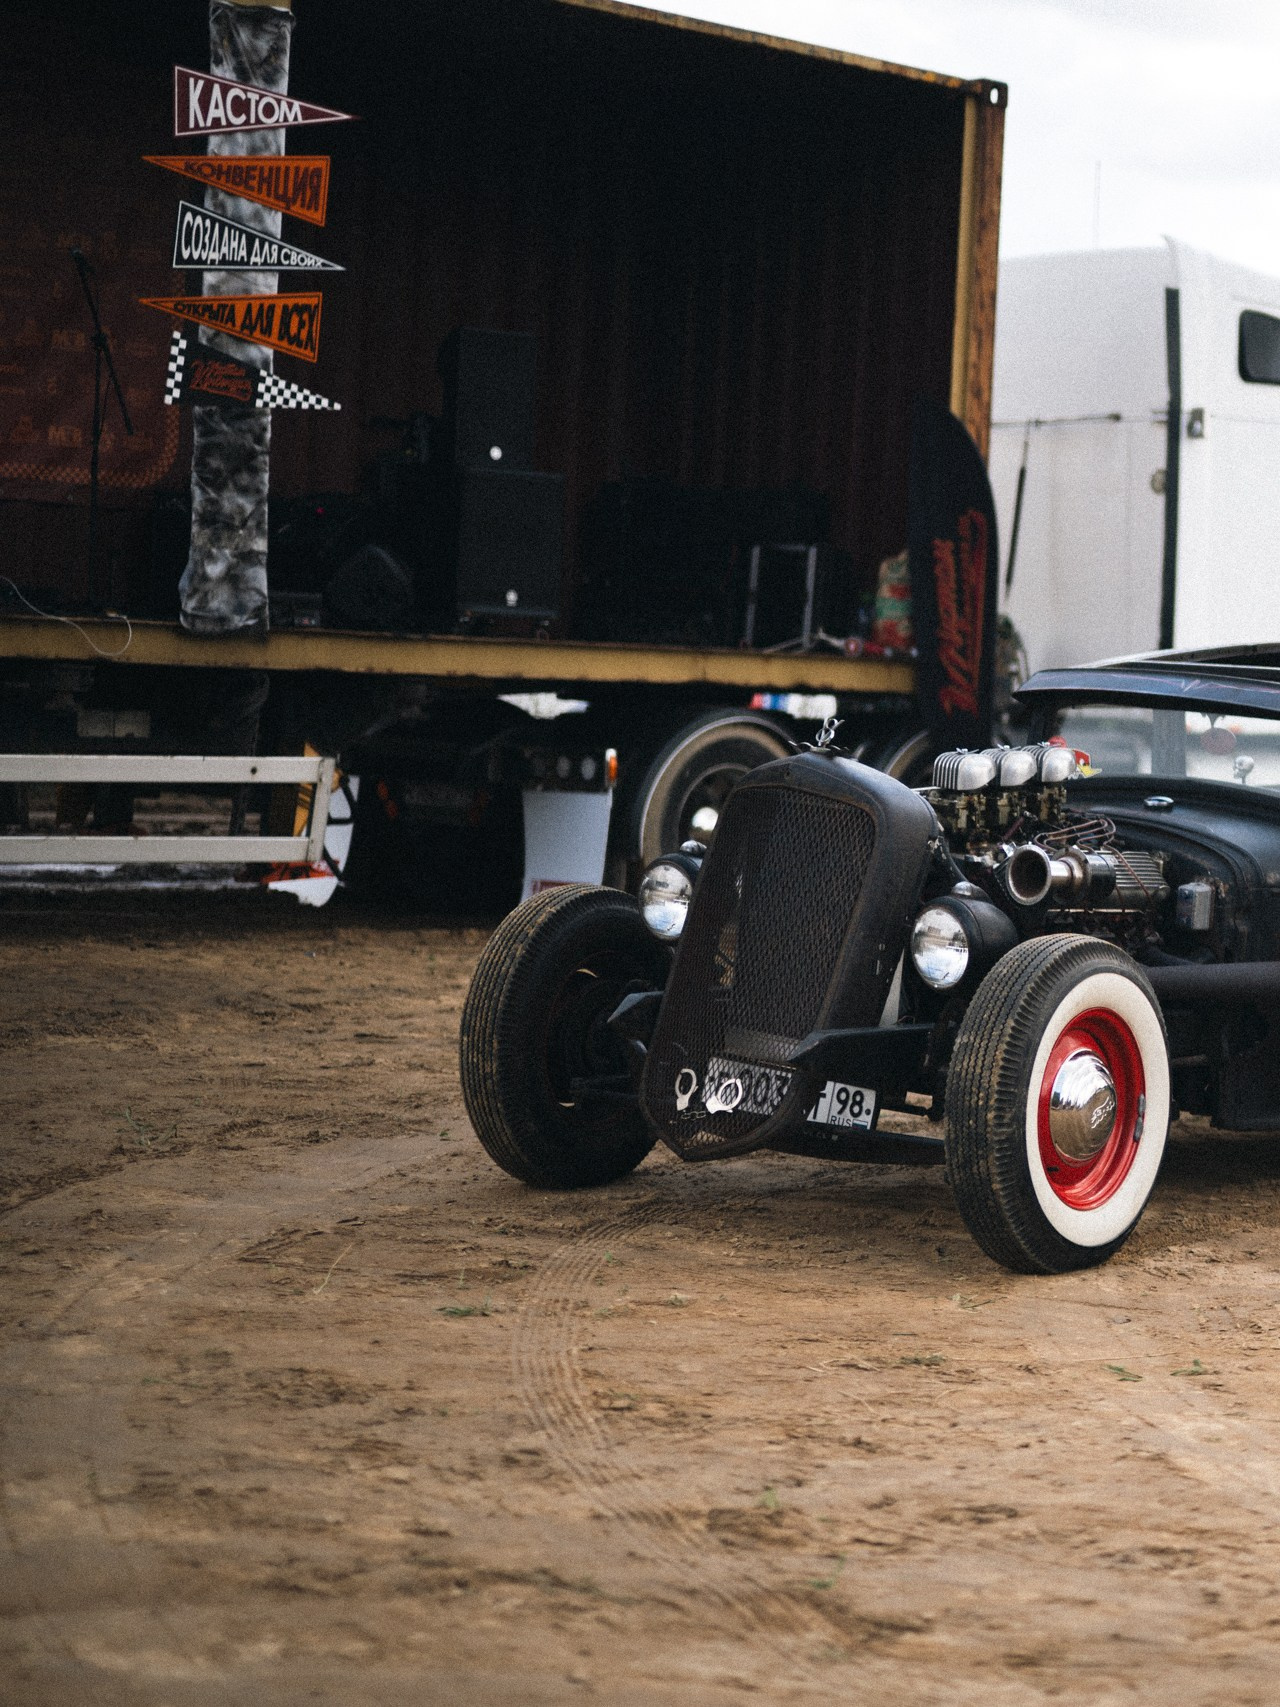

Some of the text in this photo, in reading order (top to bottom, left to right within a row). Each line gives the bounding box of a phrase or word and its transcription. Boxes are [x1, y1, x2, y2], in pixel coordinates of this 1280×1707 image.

[188, 77, 303, 129] КАСТОМ
[183, 161, 322, 212] КОНВЕНЦИЯ
[181, 211, 323, 269] СОЗДАНА ДЛЯ СВОИХ
[173, 302, 319, 351] ОТКРЫТА ДЛЯ ВСЕХ
[830, 1115, 852, 1128] RUS
[836, 1086, 865, 1118] 98
